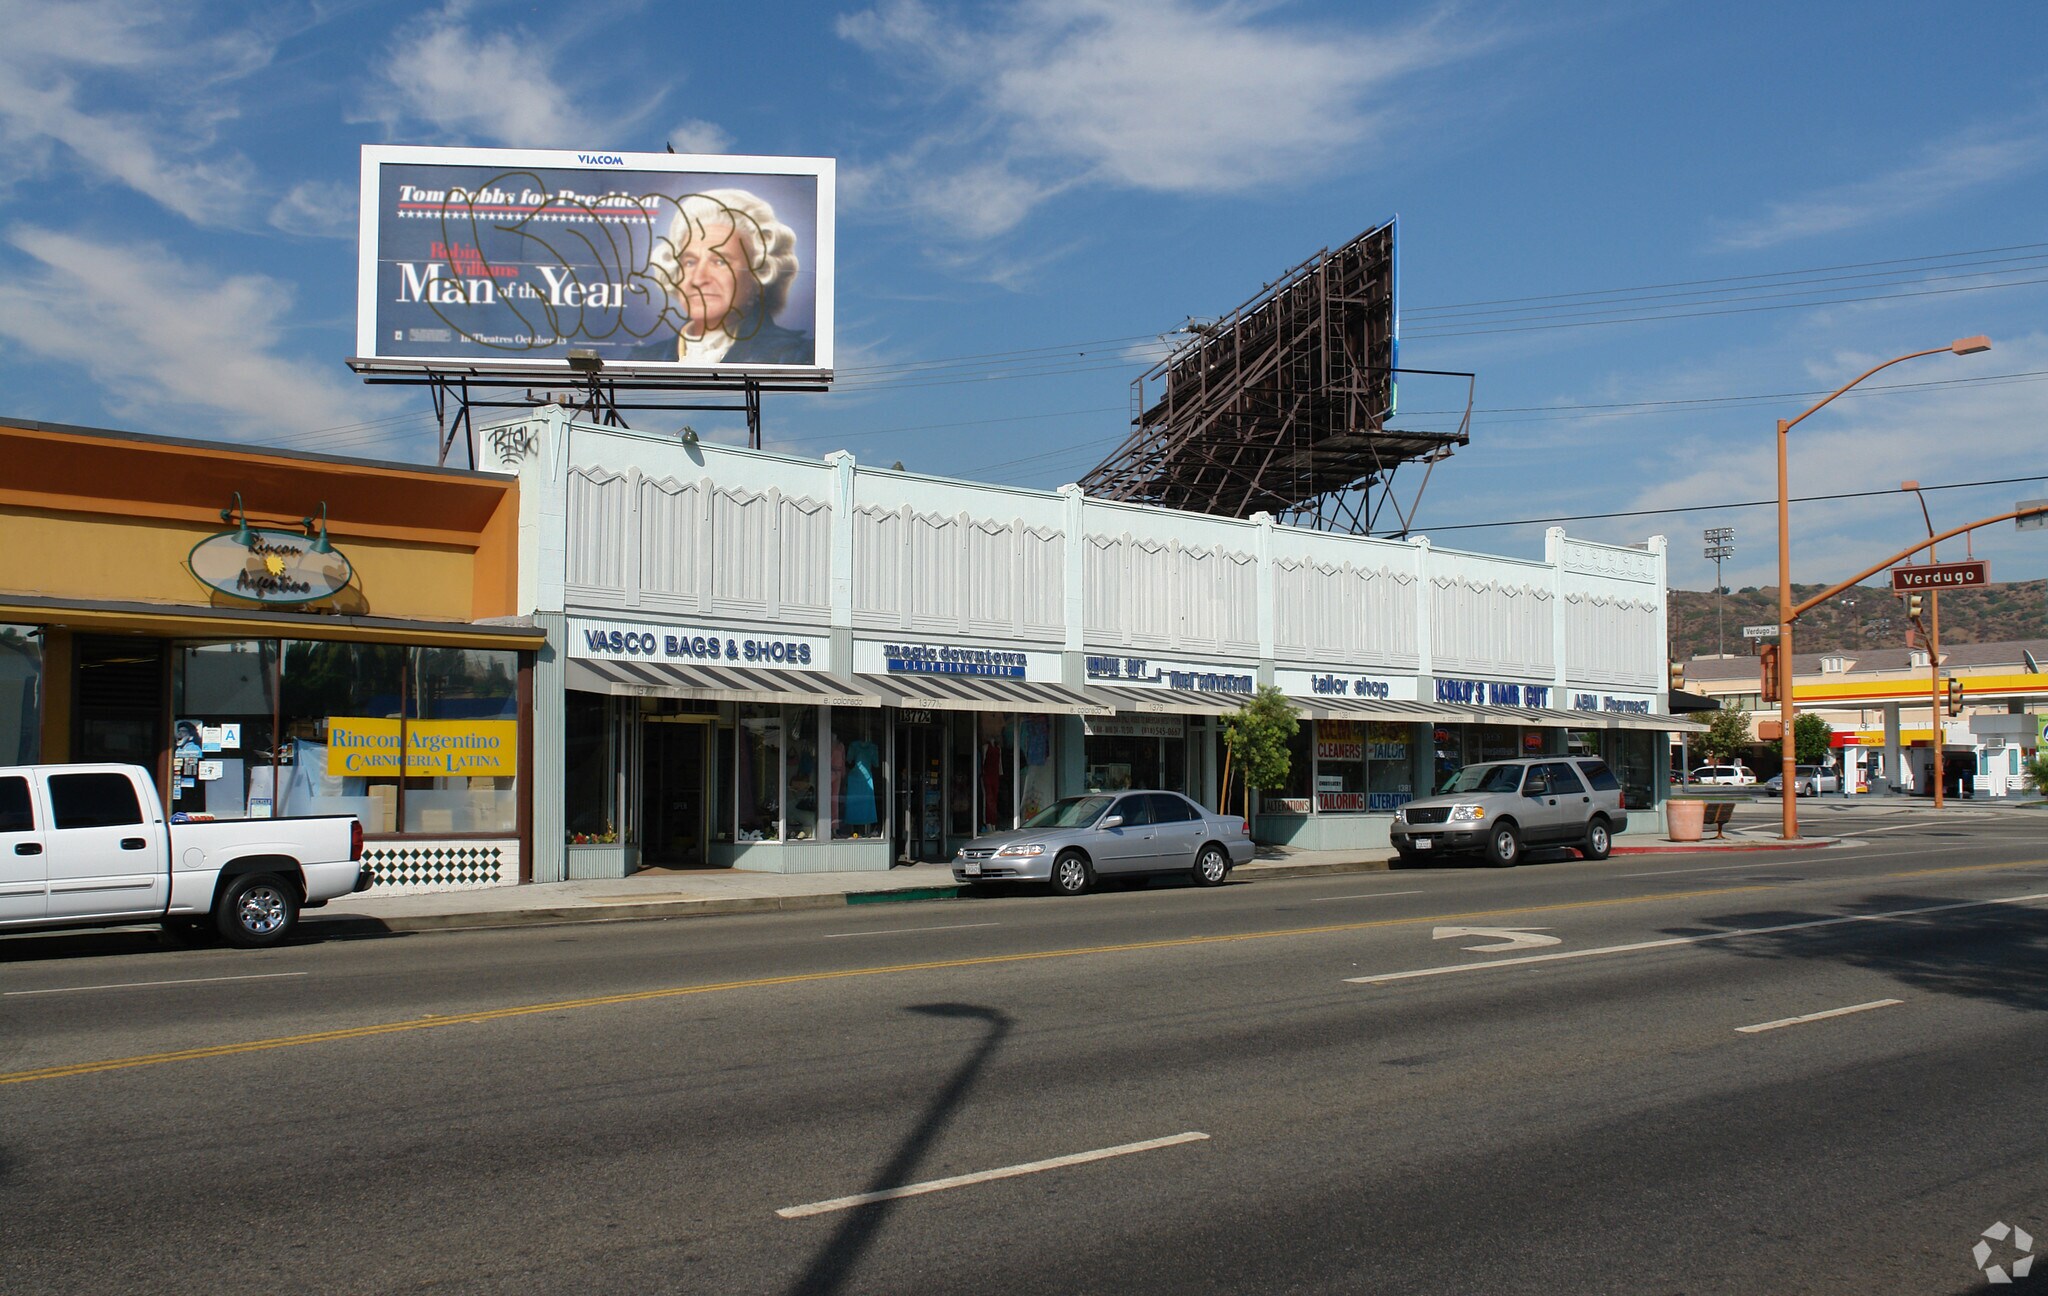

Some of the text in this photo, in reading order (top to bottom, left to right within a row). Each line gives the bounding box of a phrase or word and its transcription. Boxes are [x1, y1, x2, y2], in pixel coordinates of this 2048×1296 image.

[578, 154, 624, 165] VIACOM
[400, 185, 661, 209] Tom Dobbs for President
[430, 241, 482, 259] Robin
[452, 261, 519, 278] Williams
[396, 262, 636, 308] Man of the Year
[460, 334, 471, 343] In
[473, 334, 513, 344] Theatres
[515, 334, 554, 345] October
[248, 534, 303, 555] Rincon
[237, 568, 311, 598] Argentino
[1903, 571, 1974, 585] Verdugo
[1746, 627, 1770, 636] Verdugo
[585, 629, 812, 663] VASCO BAGS & SHOES
[884, 644, 1027, 666] magic downtown
[904, 660, 1013, 676] CLOTHING STORE
[1086, 656, 1120, 676] UNIQUE
[1311, 674, 1389, 700] tailor shop
[1436, 680, 1548, 709] KOKO'S HAIR CUT
[832, 697, 863, 706] colorado
[1150, 703, 1164, 711] 1379
[1603, 696, 1649, 715] Pharmacy
[1078, 706, 1102, 715] colorado
[225, 730, 235, 740] A
[332, 728, 500, 752] Rincon Argentino
[1317, 743, 1361, 759] CLEANERS
[1373, 744, 1405, 759] TAILOR
[446, 754, 500, 772] LATINA
[1398, 784, 1412, 792] 1381
[1266, 798, 1310, 813] ALTERATIONS
[1318, 793, 1363, 810] TAILORING
[1368, 793, 1412, 809] ALTERATION
